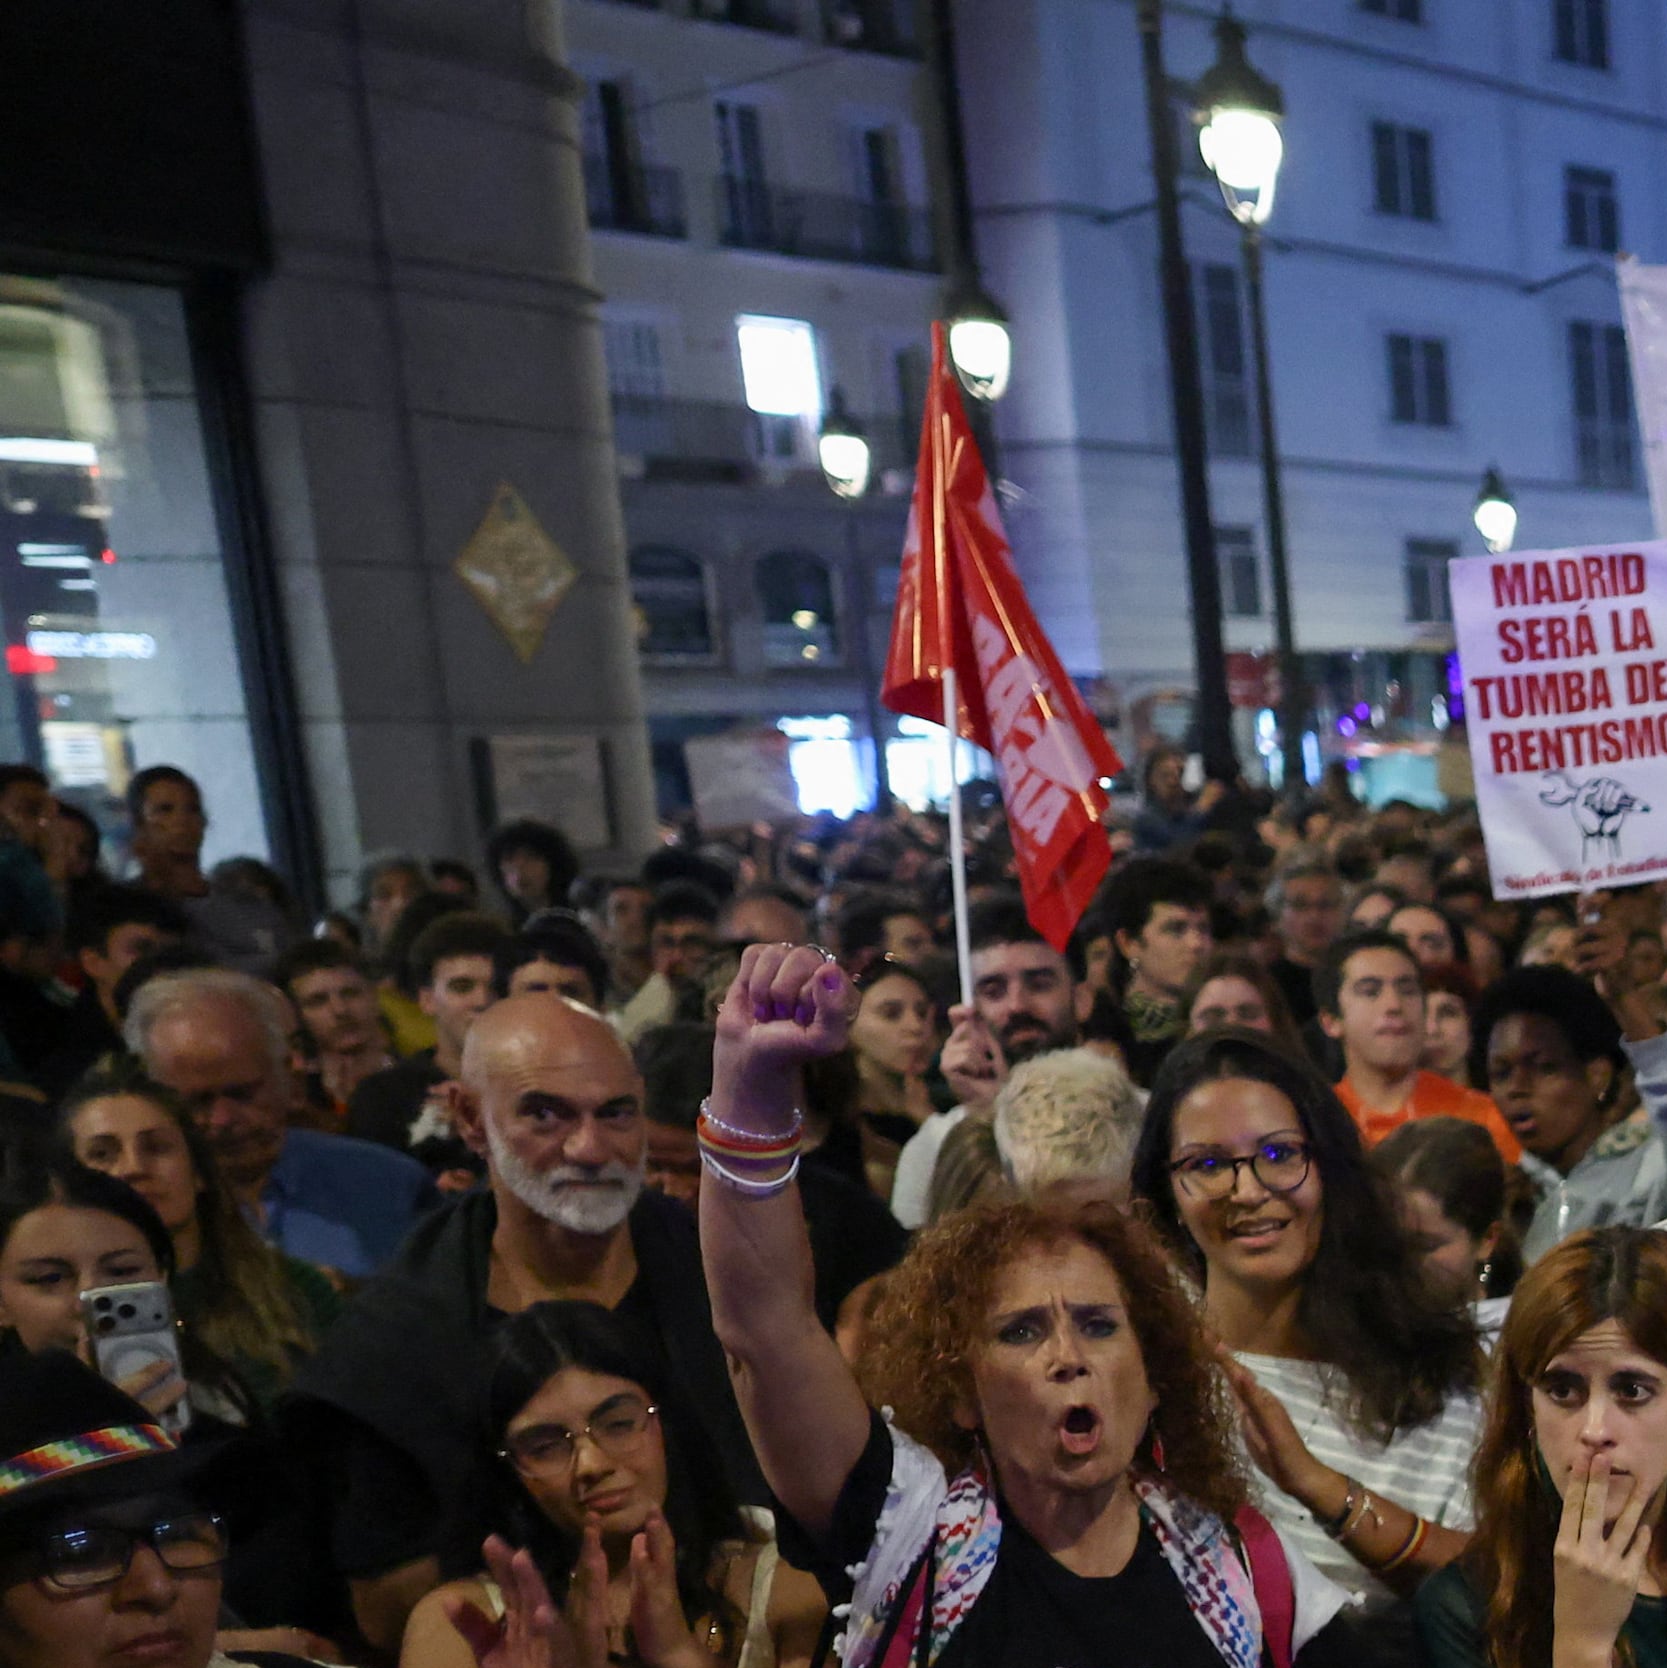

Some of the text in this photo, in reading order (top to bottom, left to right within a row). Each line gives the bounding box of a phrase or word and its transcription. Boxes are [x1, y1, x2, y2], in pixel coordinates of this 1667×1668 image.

[1491, 553, 1646, 607] MADRID
[1499, 604, 1655, 663] SERÁ LA
[1470, 668, 1611, 720] TUMBA
